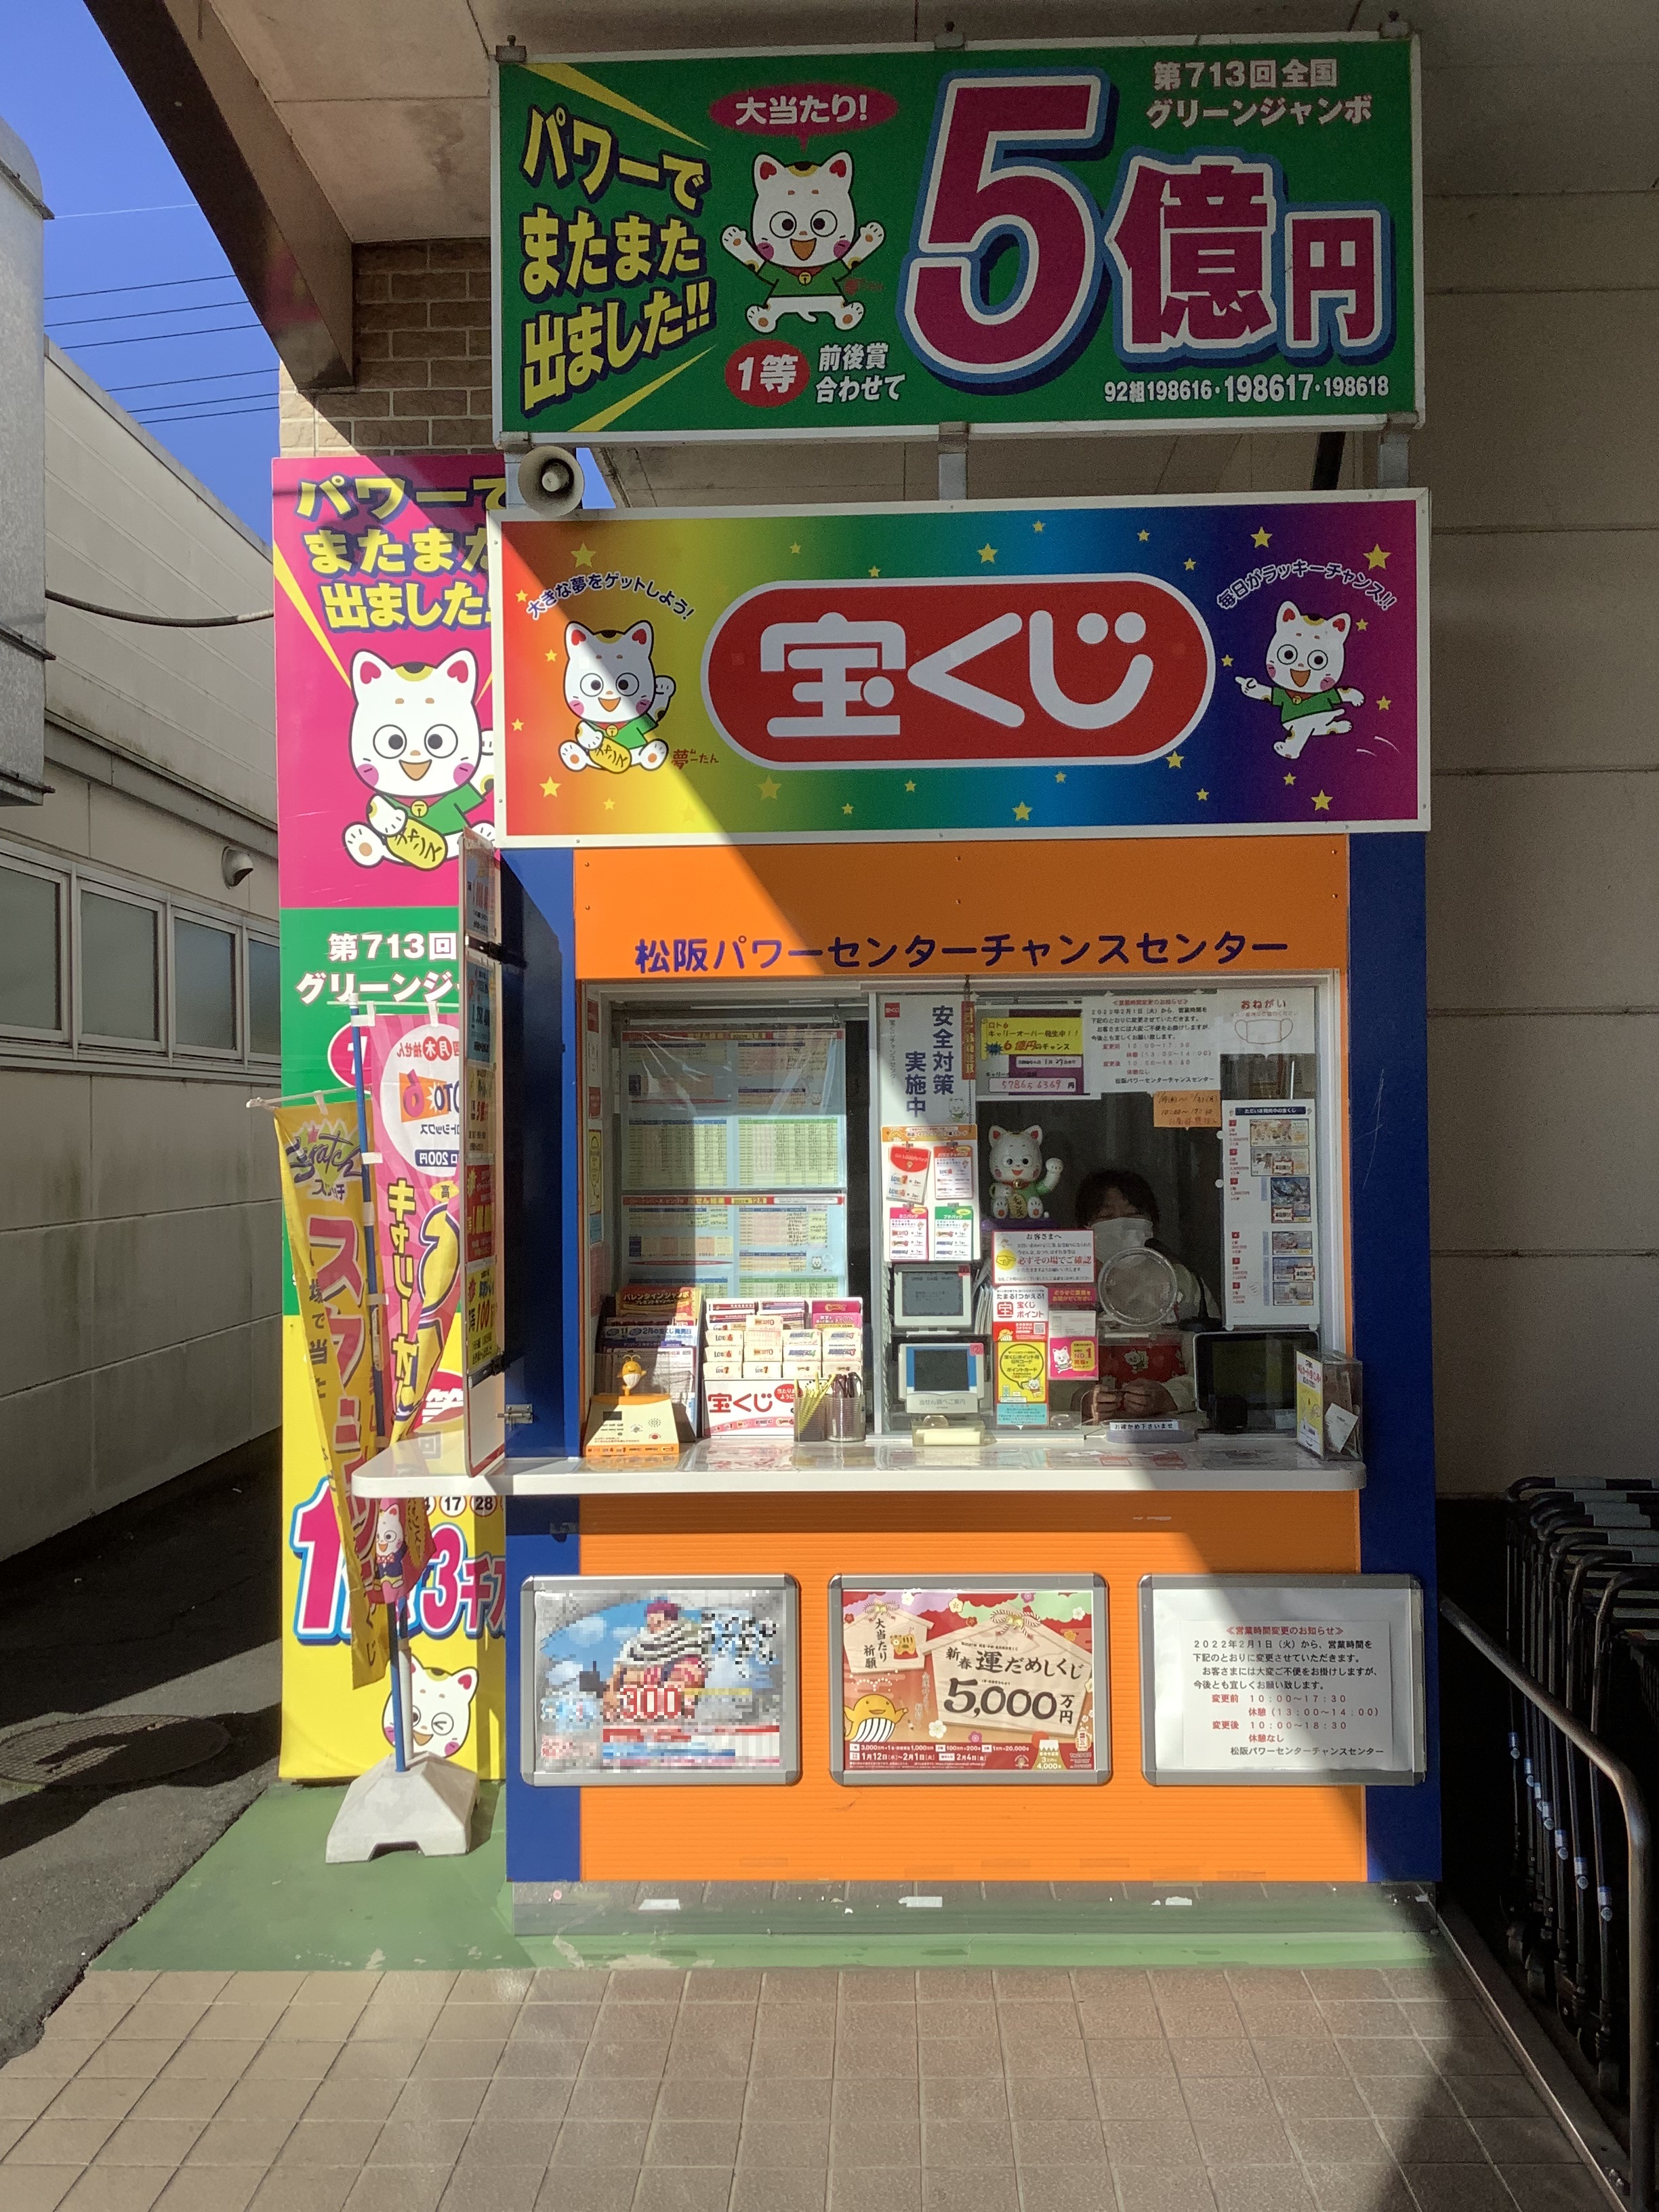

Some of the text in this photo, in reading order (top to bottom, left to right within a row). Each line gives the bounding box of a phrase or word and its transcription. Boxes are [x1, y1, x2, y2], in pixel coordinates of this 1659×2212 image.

[1153, 59, 1338, 89] 第713回全国
[735, 94, 867, 125] 大当たり!
[1146, 94, 1372, 129] グリーンジャンボ
[522, 106, 708, 211] パワーで
[905, 75, 1384, 373] 5億円
[522, 207, 701, 295] またまた
[523, 280, 711, 411] 出ました!!
[819, 342, 888, 371] 前後賞
[738, 354, 798, 392] 1等
[815, 374, 906, 403] 合わせて
[527, 572, 695, 620] 大きな夢をゲットしよう!
[1216, 558, 1397, 611] 毎日がラッキーチャンス!!
[760, 609, 1154, 739] 宝くじ
[594, 743, 629, 768] チャンス
[394, 827, 443, 862] チャンス
[328, 933, 457, 961] 第713回
[634, 930, 1289, 975] 松阪パワーセンターチャンスセンター
[295, 970, 459, 1004] グリーンジ
[1241, 999, 1286, 1010] おねがい
[932, 1004, 954, 1095] 安全対策
[905, 1050, 927, 1118] 実施中
[1026, 1233, 1062, 1241] お客さまへ
[1017, 1256, 1092, 1265] 必ずその場でご確認
[623, 1290, 690, 1301] バレンタインジャンボ
[708, 1393, 773, 1413] 宝くじ
[445, 1496, 493, 1511] 17 28
[875, 1618, 887, 1662] 大当たり
[863, 1645, 878, 1669] 祈願
[945, 1646, 1084, 1680] 新春運だめしくじ
[1193, 1654, 1360, 1663] 下記のとおりに変更させていただきます。
[1202, 1666, 1377, 1677] お客さまには大変ご不便をお掛けしますが、
[1193, 1680, 1324, 1690] 今後とも宜しくお願い致します。
[1212, 1694, 1239, 1704] 変更前
[1212, 1721, 1240, 1730] 変更後
[1248, 1734, 1284, 1743] 休憩なし
[1230, 1746, 1385, 1756] 松阪パワーセンターチャンスセンター
